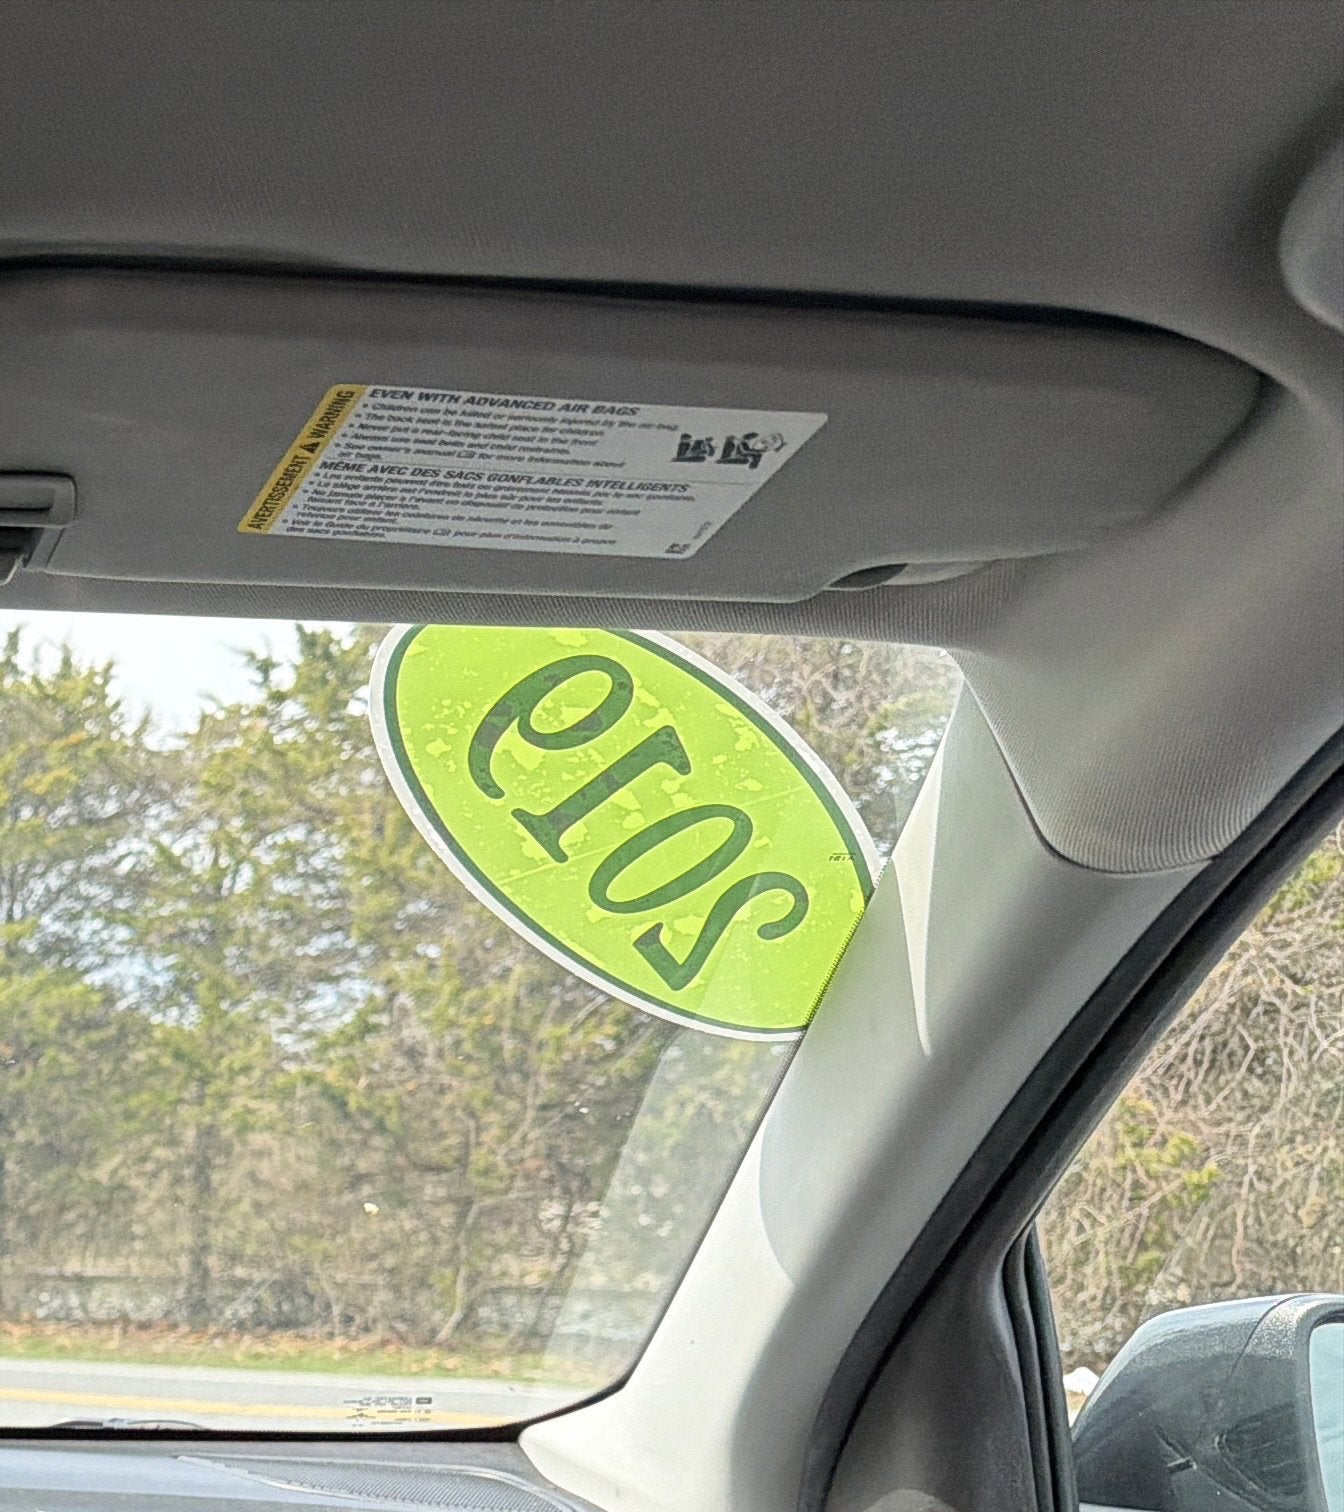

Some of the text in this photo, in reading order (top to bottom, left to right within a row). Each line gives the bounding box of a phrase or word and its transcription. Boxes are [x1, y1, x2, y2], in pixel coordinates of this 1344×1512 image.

[312, 389, 355, 439] WARNING
[369, 389, 640, 416] EVEN WITH ADVANCED AIR BAGS
[247, 454, 311, 531] AVERTISSEMENT
[318, 459, 690, 493] MÊME AVEC DES SACS GONFLABLES INTELLIGENTS
